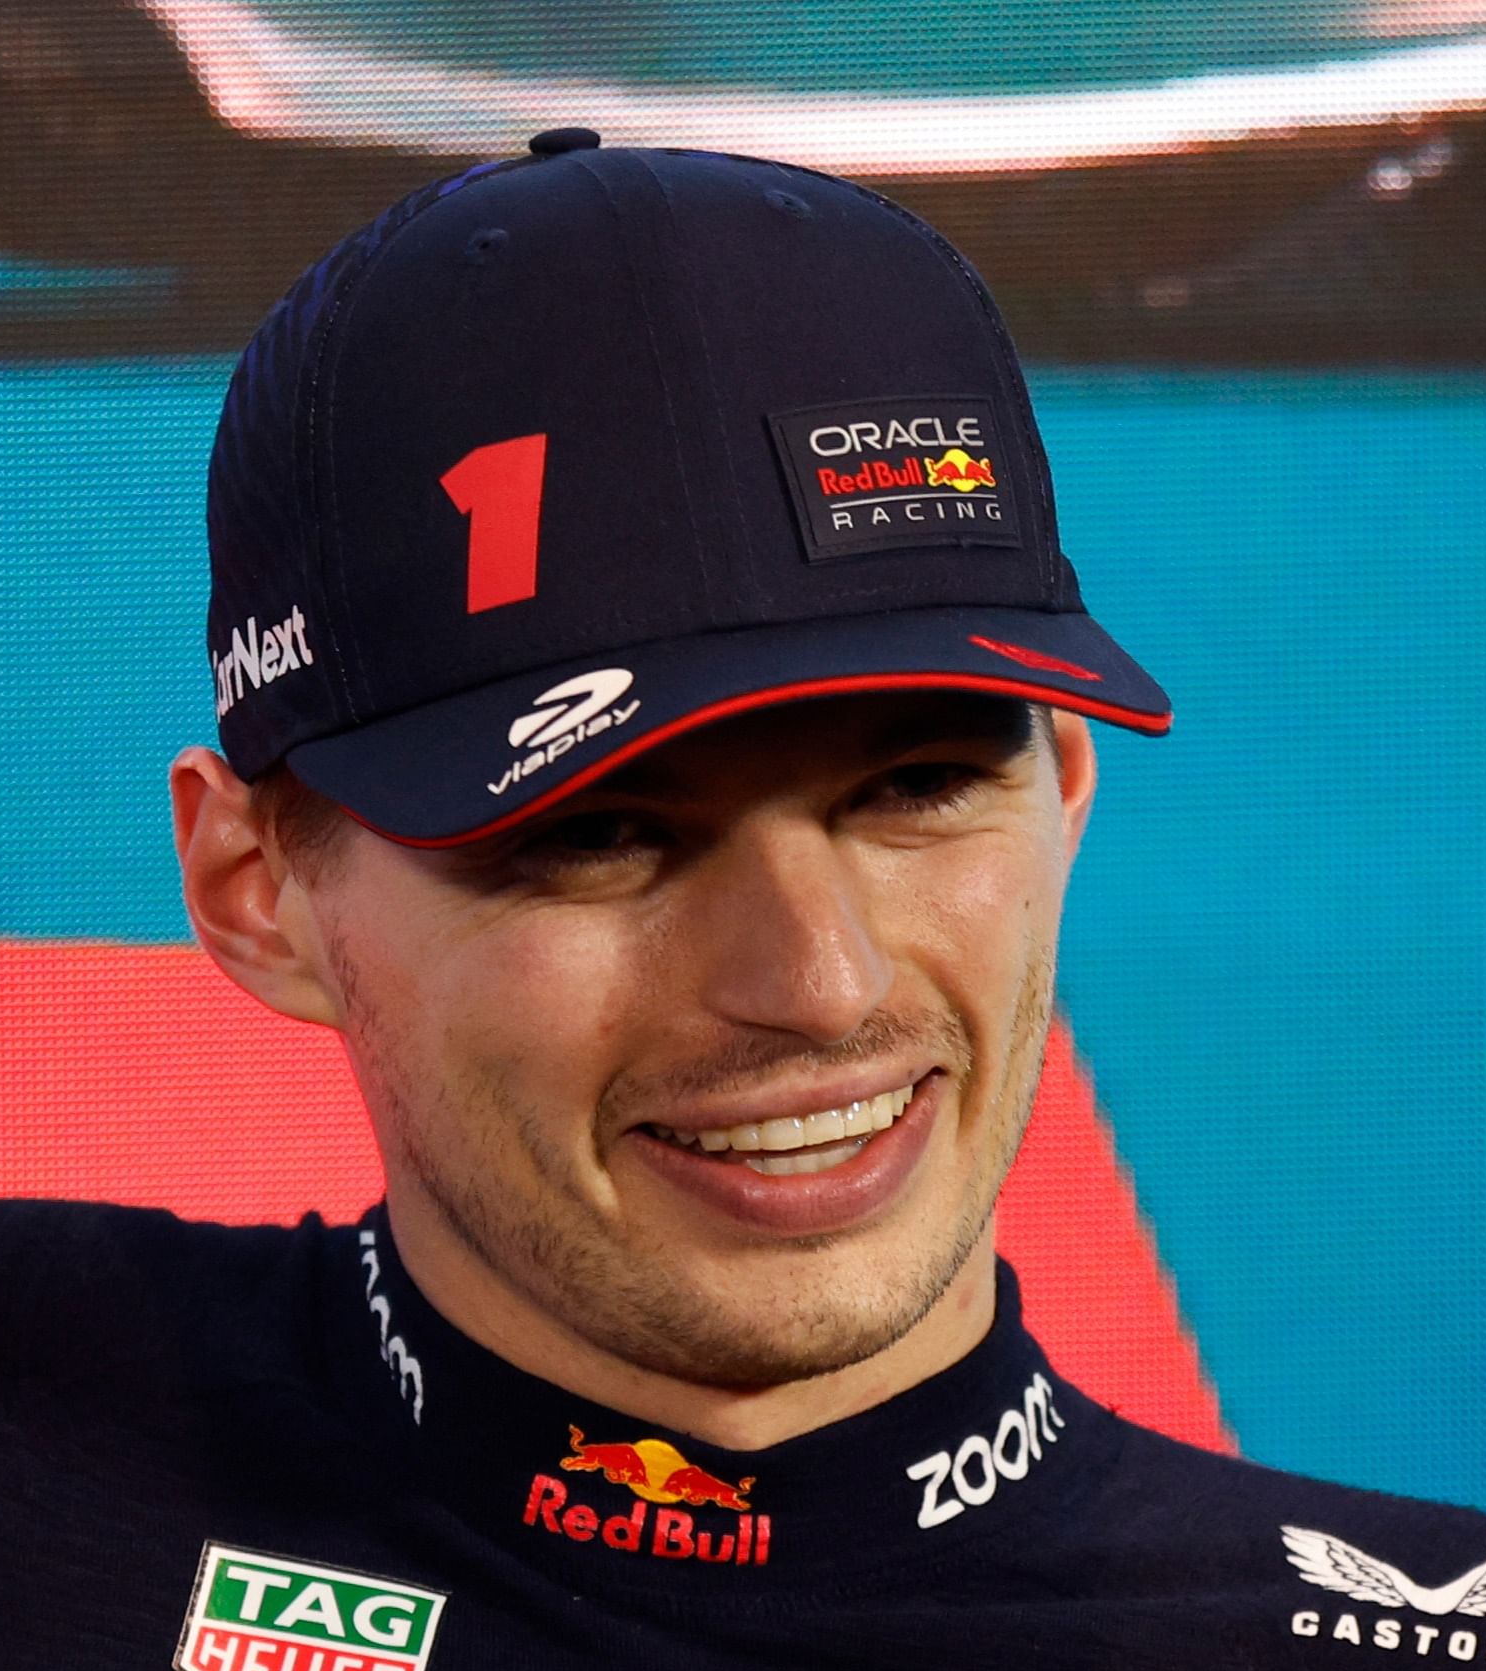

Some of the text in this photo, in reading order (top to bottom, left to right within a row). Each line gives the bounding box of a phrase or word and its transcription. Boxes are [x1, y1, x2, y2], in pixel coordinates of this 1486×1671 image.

[810, 417, 985, 457] ORACLE
[441, 433, 549, 615] 1
[831, 502, 1002, 531] RACING
[213, 604, 314, 724] arNext
[487, 699, 641, 795] viaplay
[906, 1372, 1066, 1530] zoom
[226, 1565, 417, 1647] TAG
